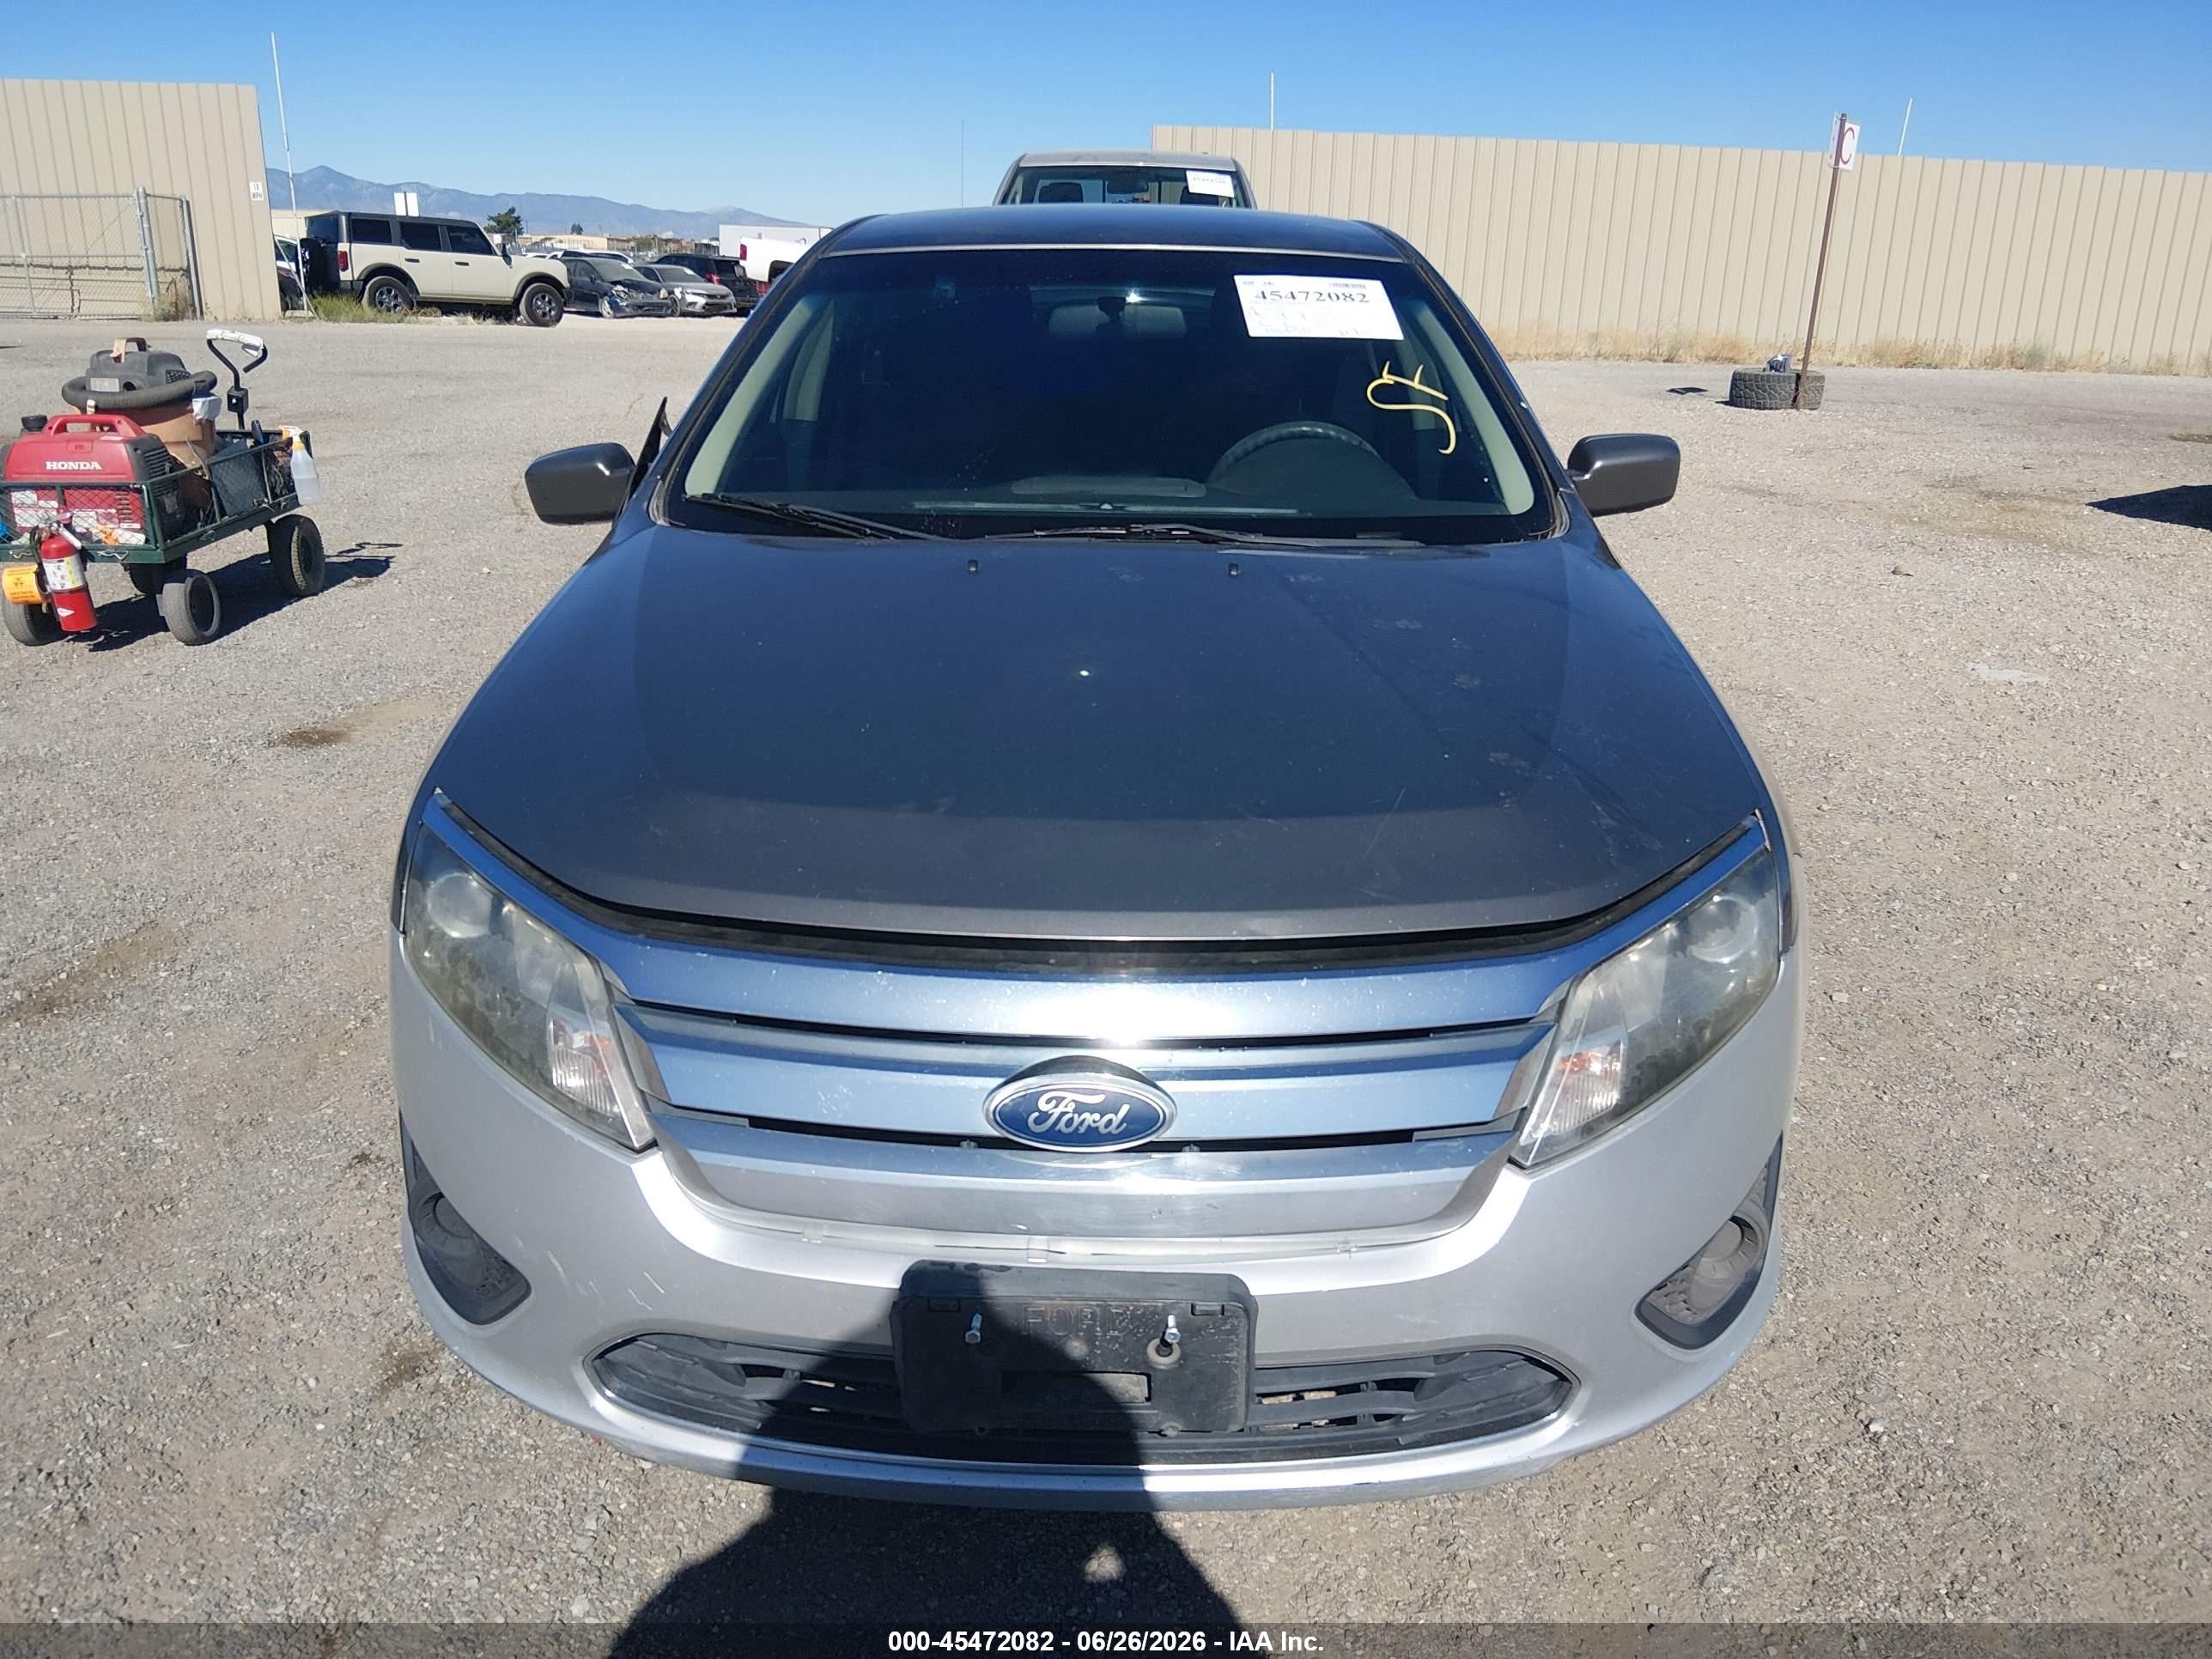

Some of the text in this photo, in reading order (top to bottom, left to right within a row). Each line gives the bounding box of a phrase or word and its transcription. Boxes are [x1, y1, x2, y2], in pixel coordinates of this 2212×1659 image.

[1254, 290, 1370, 303] 45472082
[46, 461, 102, 470] HONDA
[1028, 1091, 1131, 1134] Ford
[1022, 1304, 1131, 1335] FORD
